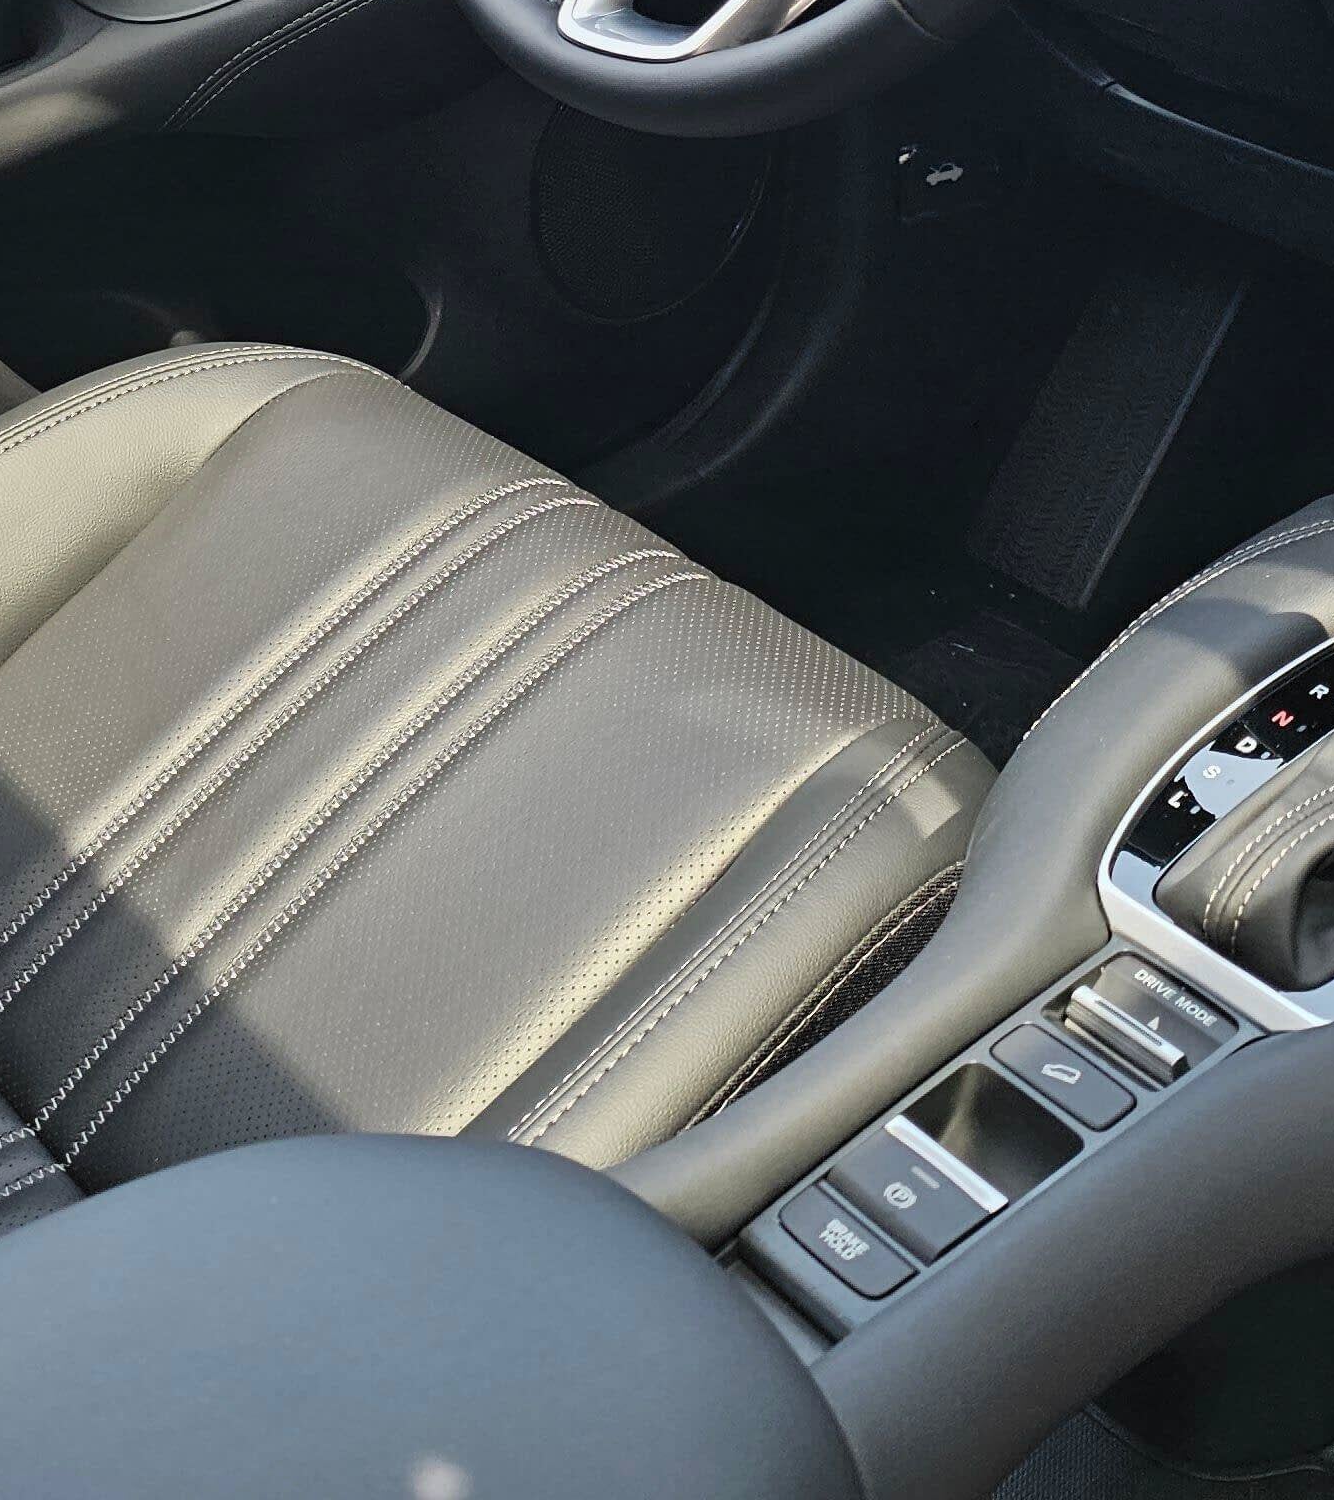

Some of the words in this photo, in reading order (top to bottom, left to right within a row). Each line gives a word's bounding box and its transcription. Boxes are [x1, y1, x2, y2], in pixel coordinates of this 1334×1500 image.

[1308, 684, 1329, 700] R
[1271, 710, 1294, 727] N
[1235, 736, 1256, 754] D
[1202, 765, 1221, 781] S
[1168, 791, 1183, 808] L
[1134, 968, 1178, 1001] DRIVE
[1174, 993, 1219, 1027] MODE
